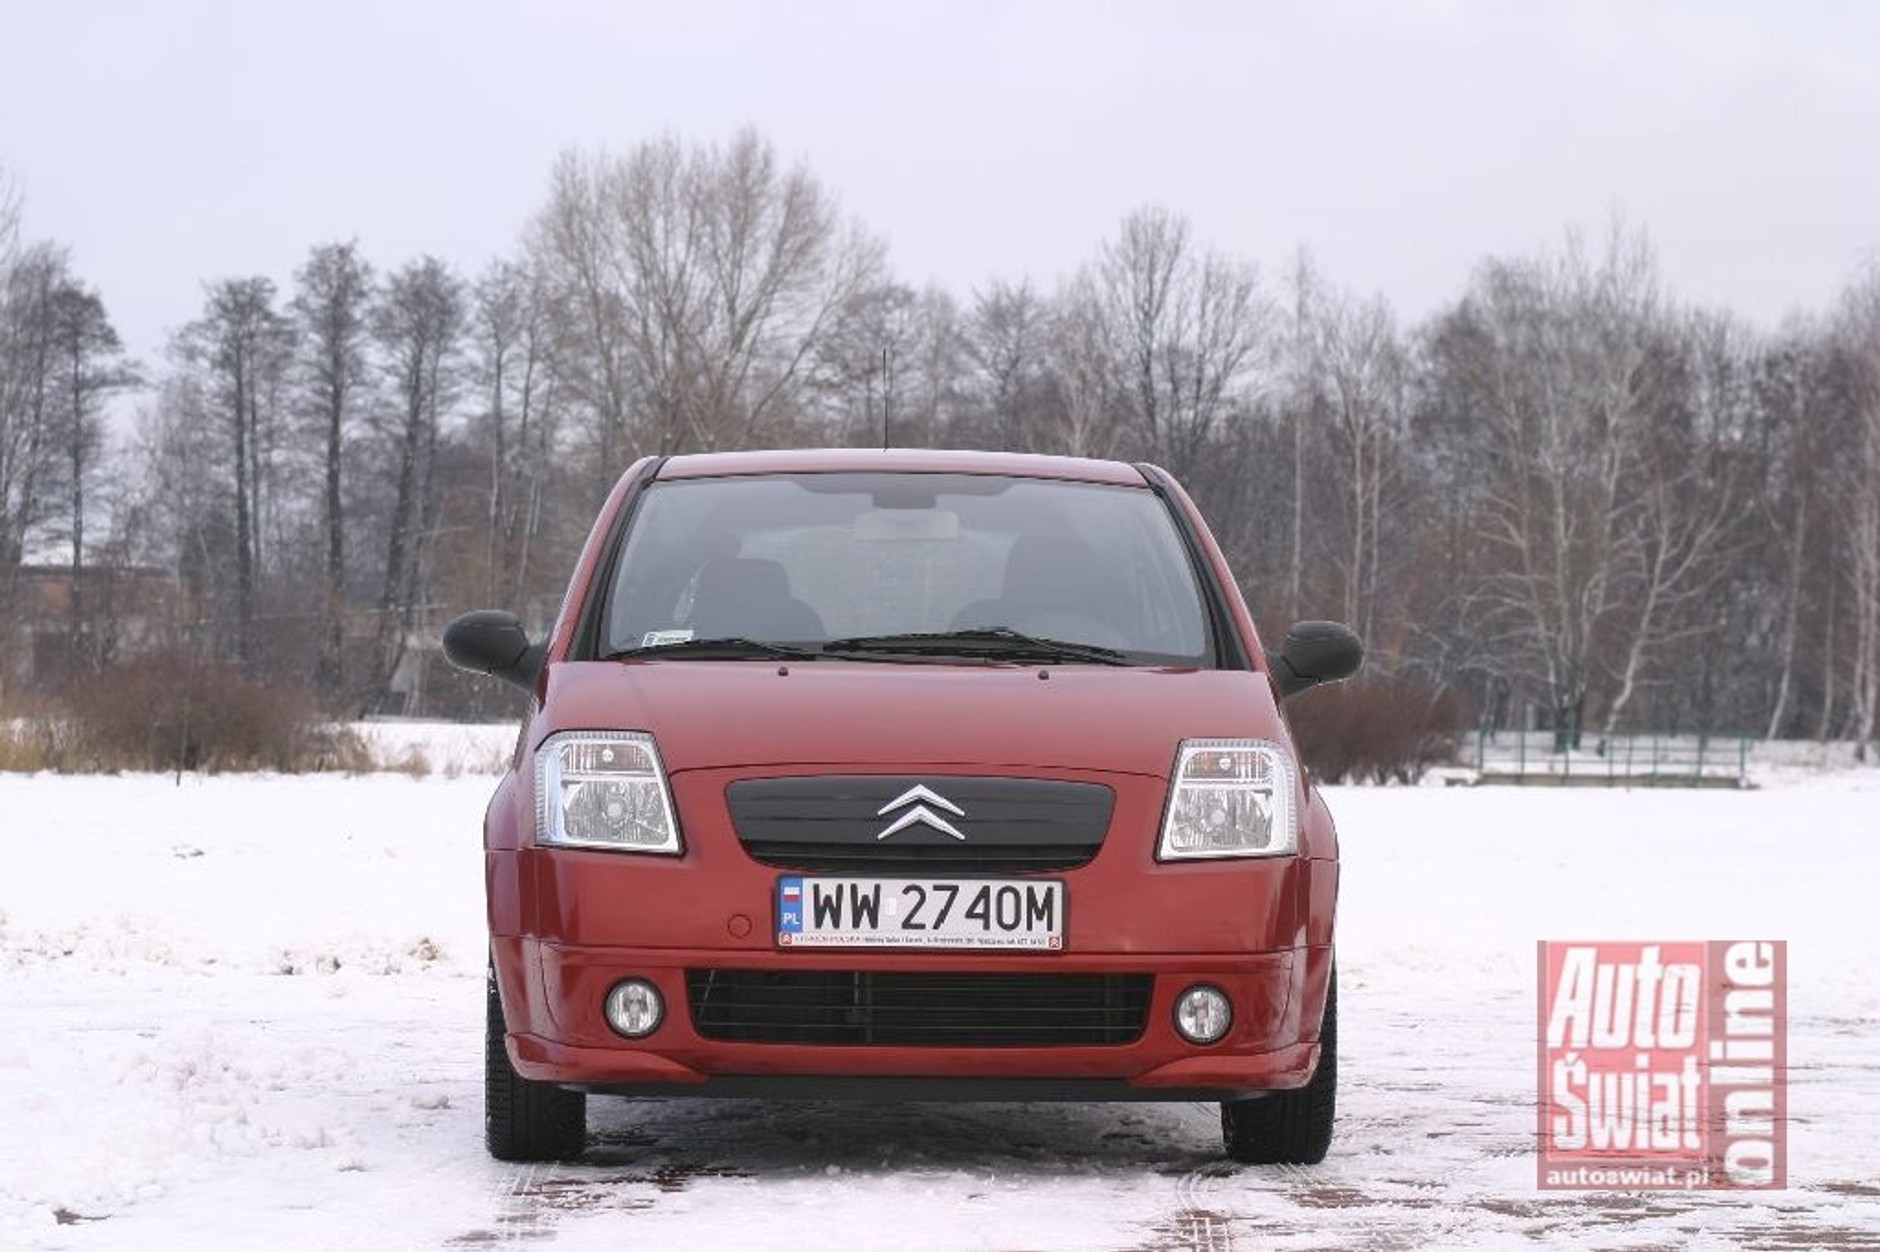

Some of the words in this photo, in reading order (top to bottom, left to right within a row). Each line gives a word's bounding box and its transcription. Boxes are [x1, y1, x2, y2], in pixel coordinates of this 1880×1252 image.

[782, 912, 800, 925] PL
[813, 883, 881, 929] WW
[901, 884, 1054, 931] 2740M
